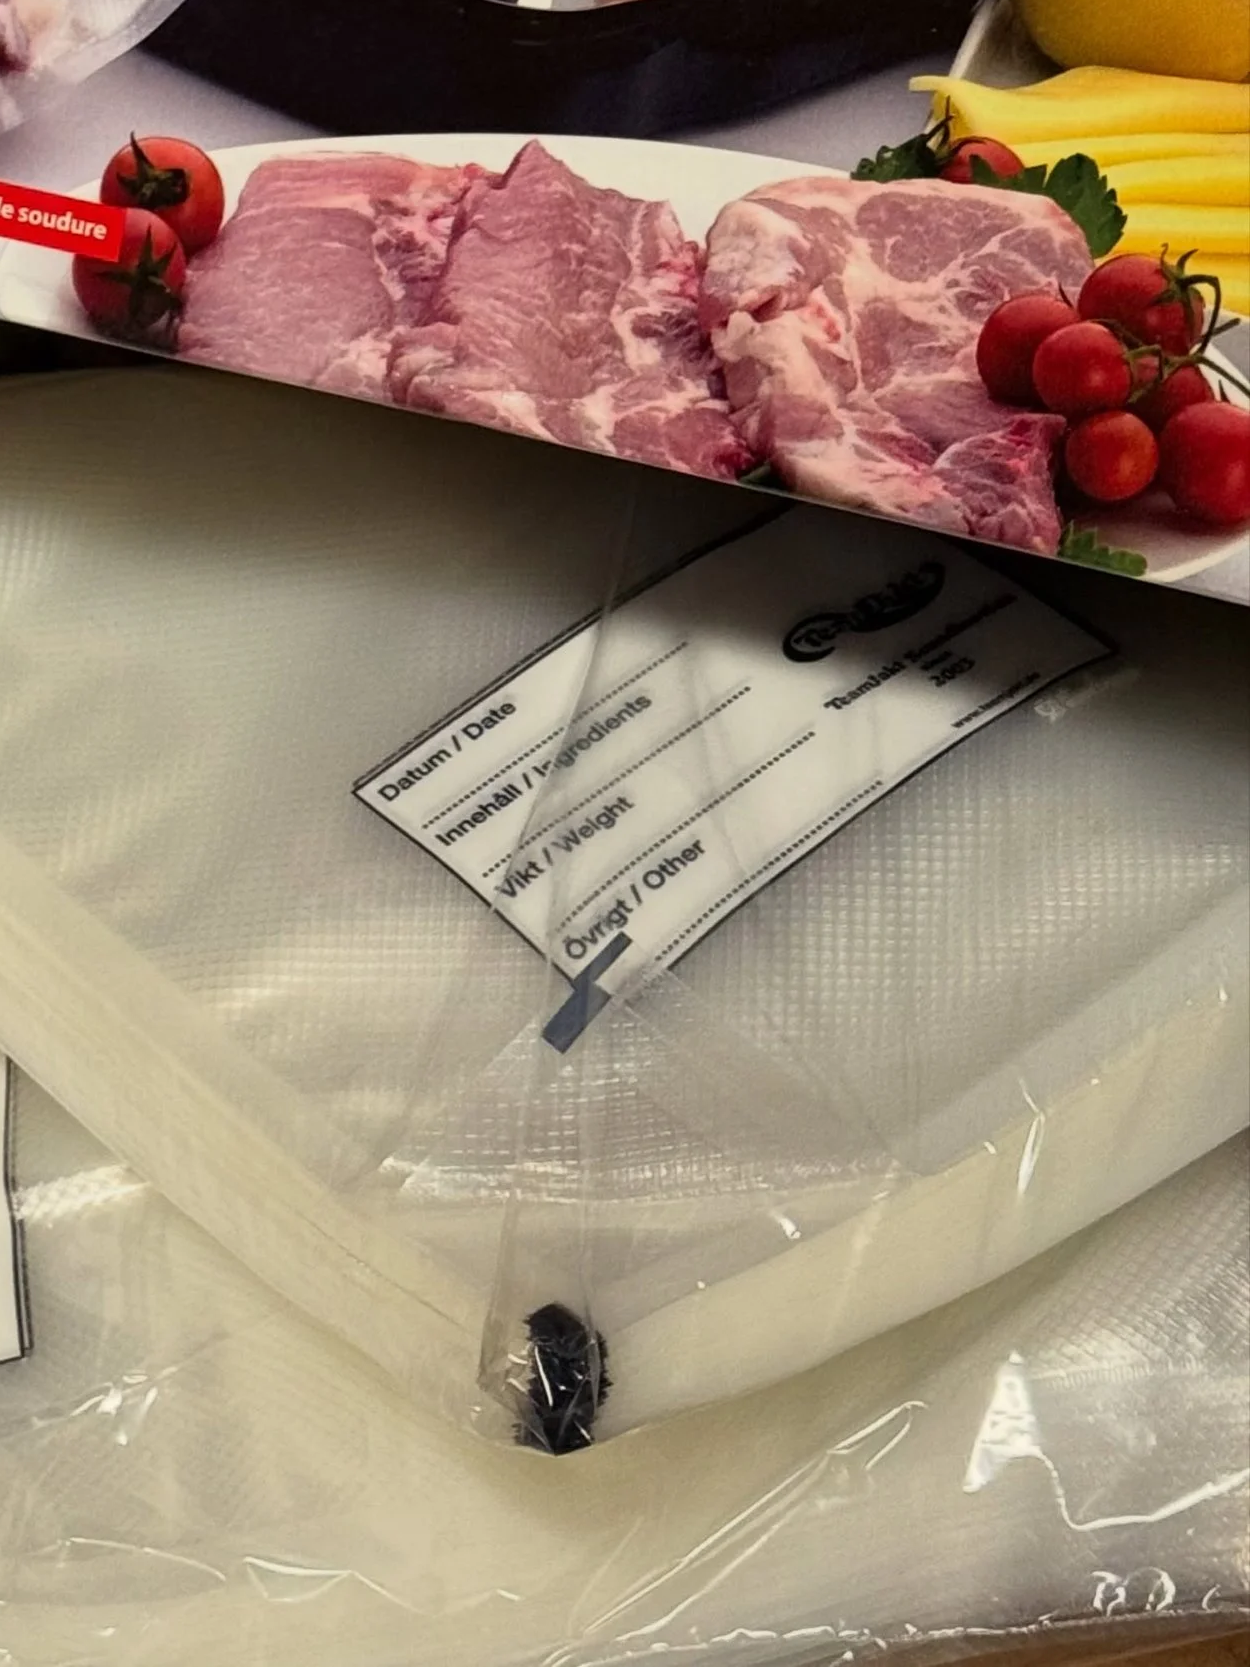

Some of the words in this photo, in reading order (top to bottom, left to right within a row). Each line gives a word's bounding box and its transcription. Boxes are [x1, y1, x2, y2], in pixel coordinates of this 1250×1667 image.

[17, 203, 108, 240] soudure
[377, 748, 454, 802] Datum
[461, 702, 517, 741] Date
[434, 783, 523, 847] Innehåll
[496, 859, 546, 899] Vikt
[551, 795, 636, 853] Weight
[562, 898, 634, 960] Övrigt
[642, 838, 706, 890] Other
